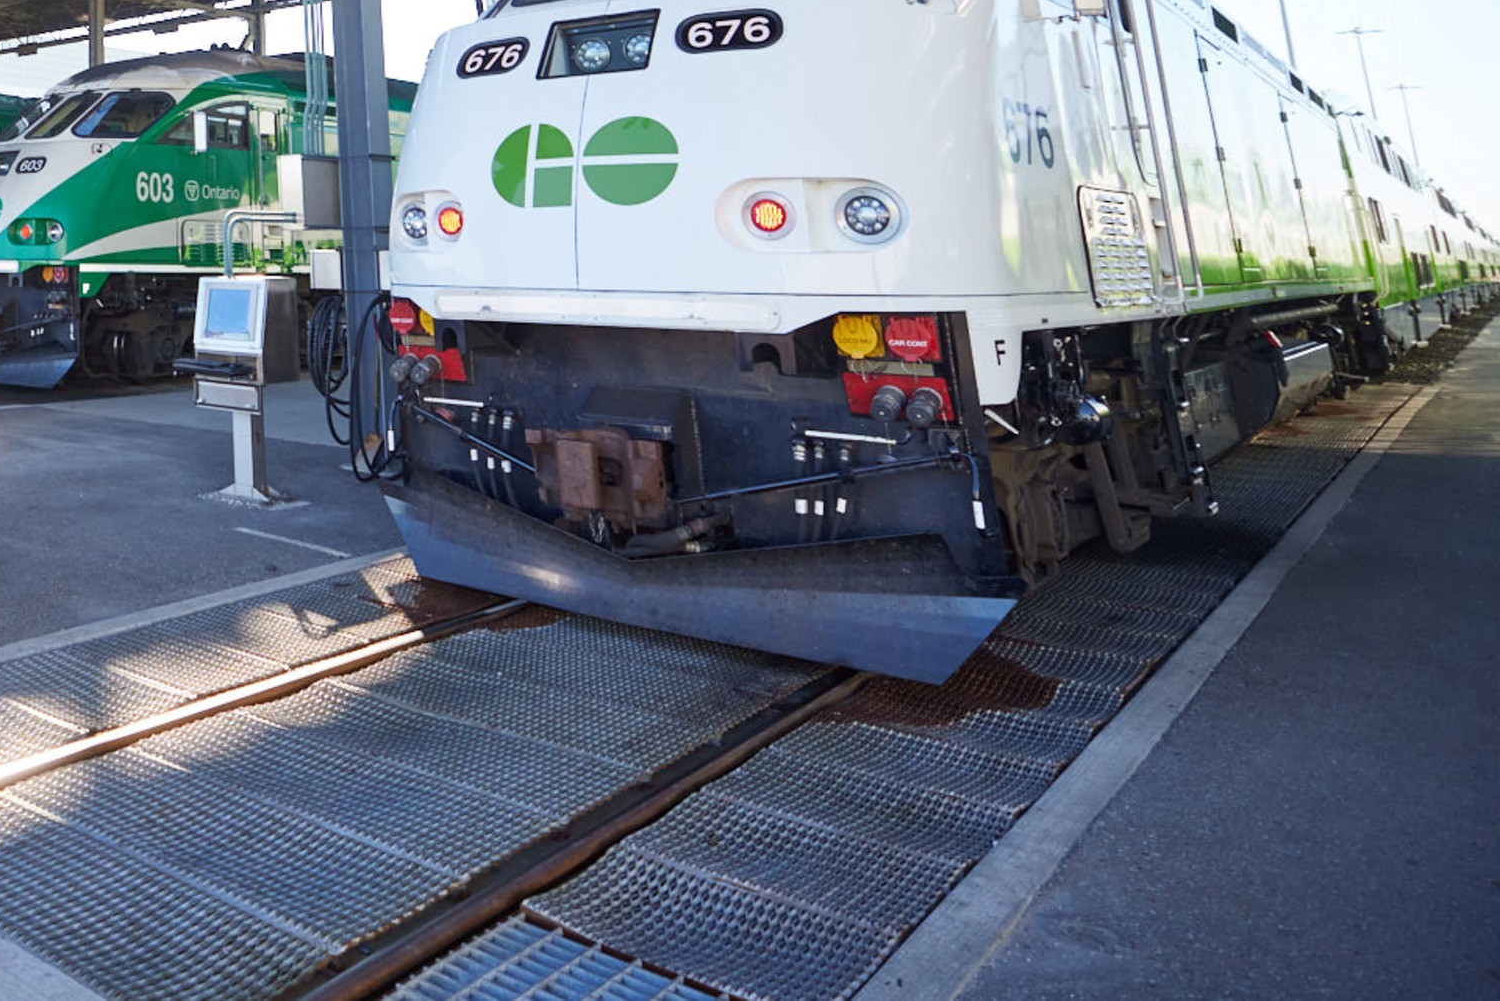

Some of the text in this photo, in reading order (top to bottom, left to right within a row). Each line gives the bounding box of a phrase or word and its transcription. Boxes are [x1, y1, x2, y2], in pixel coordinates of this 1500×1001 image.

[686, 16, 771, 48] 676
[464, 43, 523, 74] 676
[1003, 97, 1055, 170] 676
[20, 159, 43, 172] 603
[491, 115, 679, 209] GO
[136, 171, 174, 204] 603
[201, 184, 240, 201] Ontario
[888, 339, 905, 347] CAR
[994, 339, 1006, 366] F
